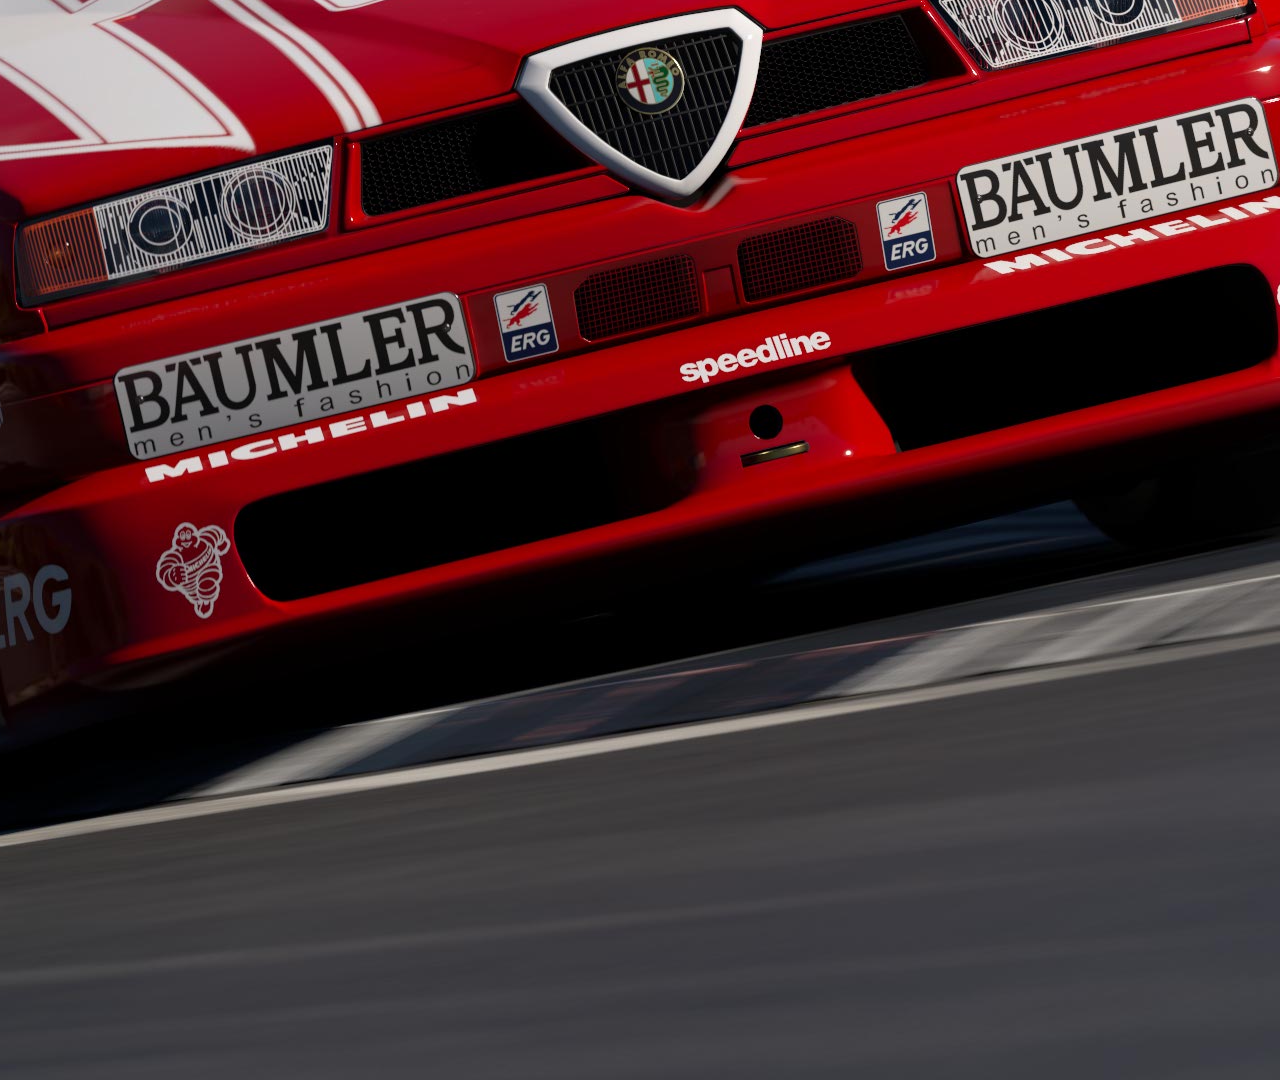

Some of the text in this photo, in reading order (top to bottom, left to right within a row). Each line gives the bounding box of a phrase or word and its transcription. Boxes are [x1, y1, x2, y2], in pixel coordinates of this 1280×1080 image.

[960, 103, 1270, 232] BÄUMLER
[974, 167, 1276, 255] men's fashion
[889, 236, 930, 262] ERG
[118, 297, 466, 434] BÄUMLER
[510, 328, 551, 354] ERG
[679, 327, 832, 384] speedline
[133, 360, 472, 457] men's fashion
[144, 387, 478, 483] MICHELIN
